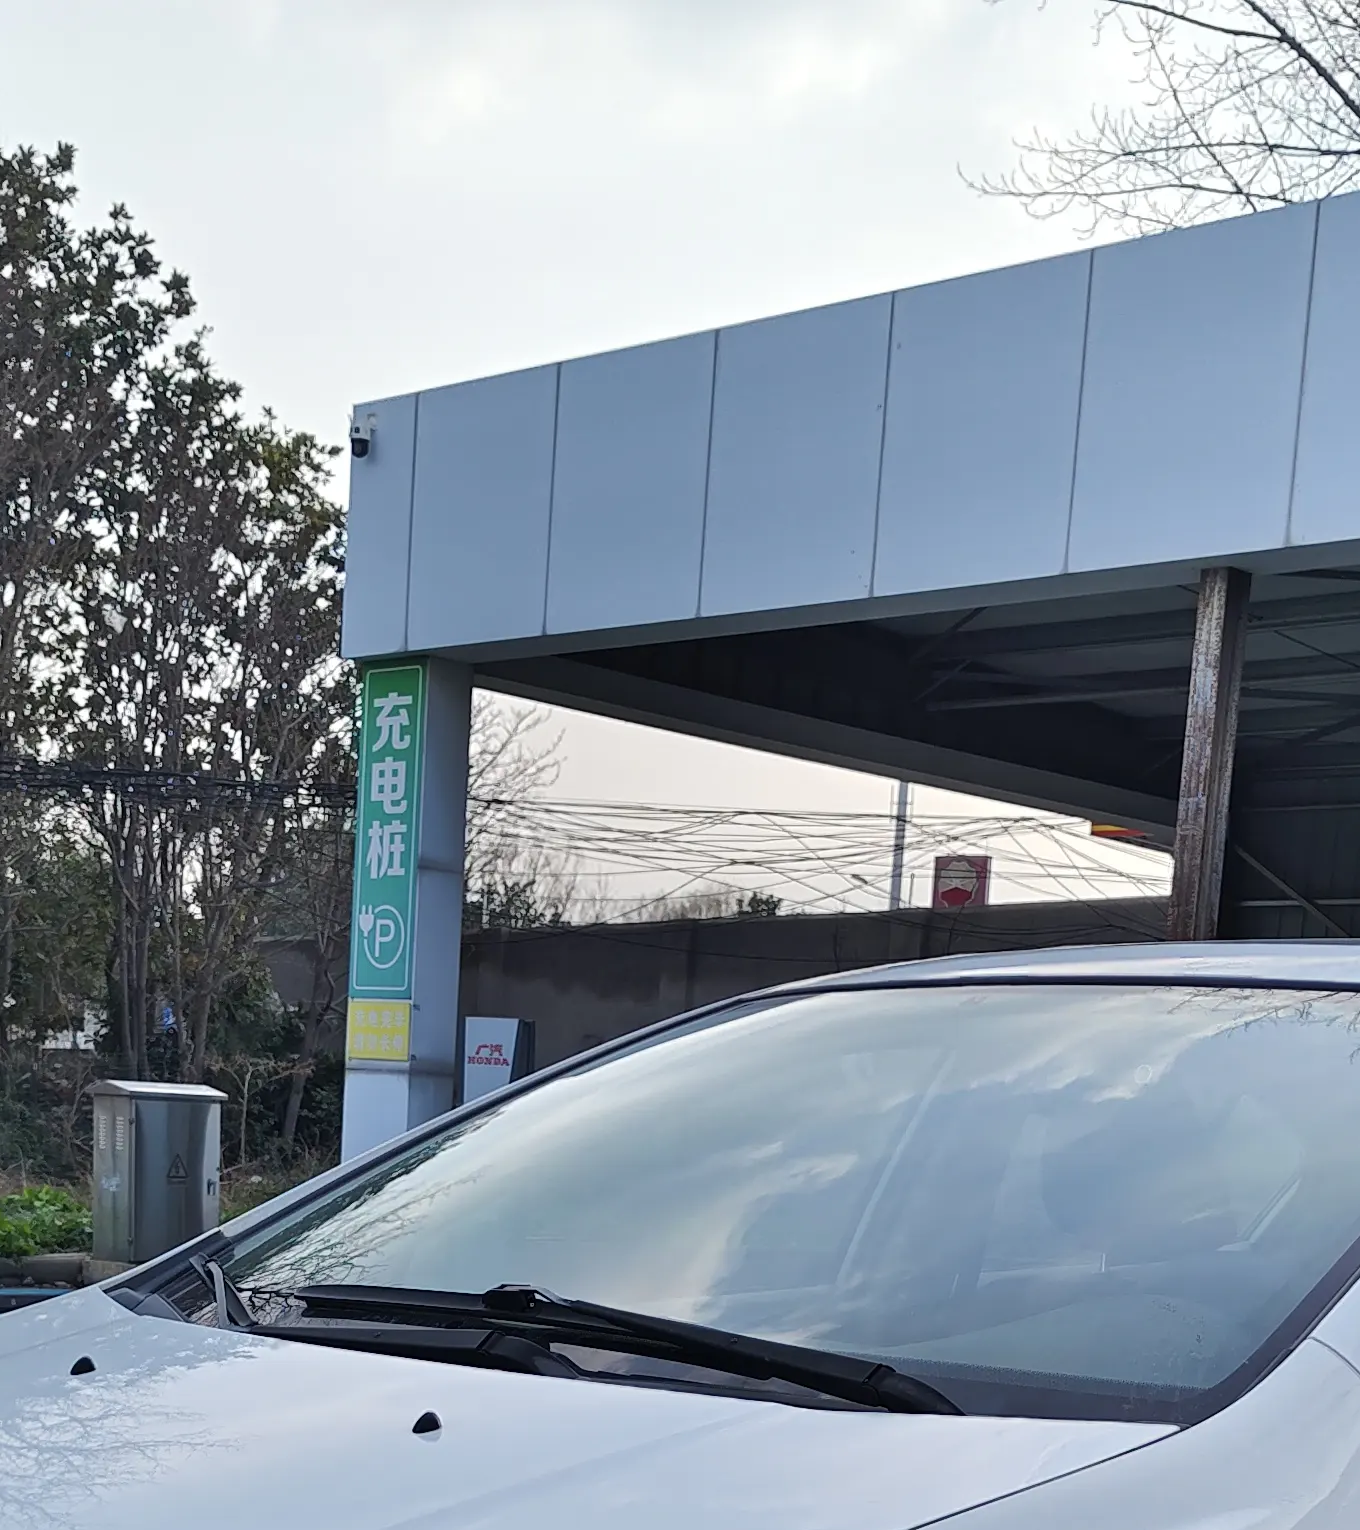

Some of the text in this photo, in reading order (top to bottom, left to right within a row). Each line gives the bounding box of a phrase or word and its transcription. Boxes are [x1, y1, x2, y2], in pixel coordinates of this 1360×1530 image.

[366, 692, 413, 880] 充电桩
[475, 1043, 503, 1056] 广汽
[467, 1056, 510, 1066] HONDA
